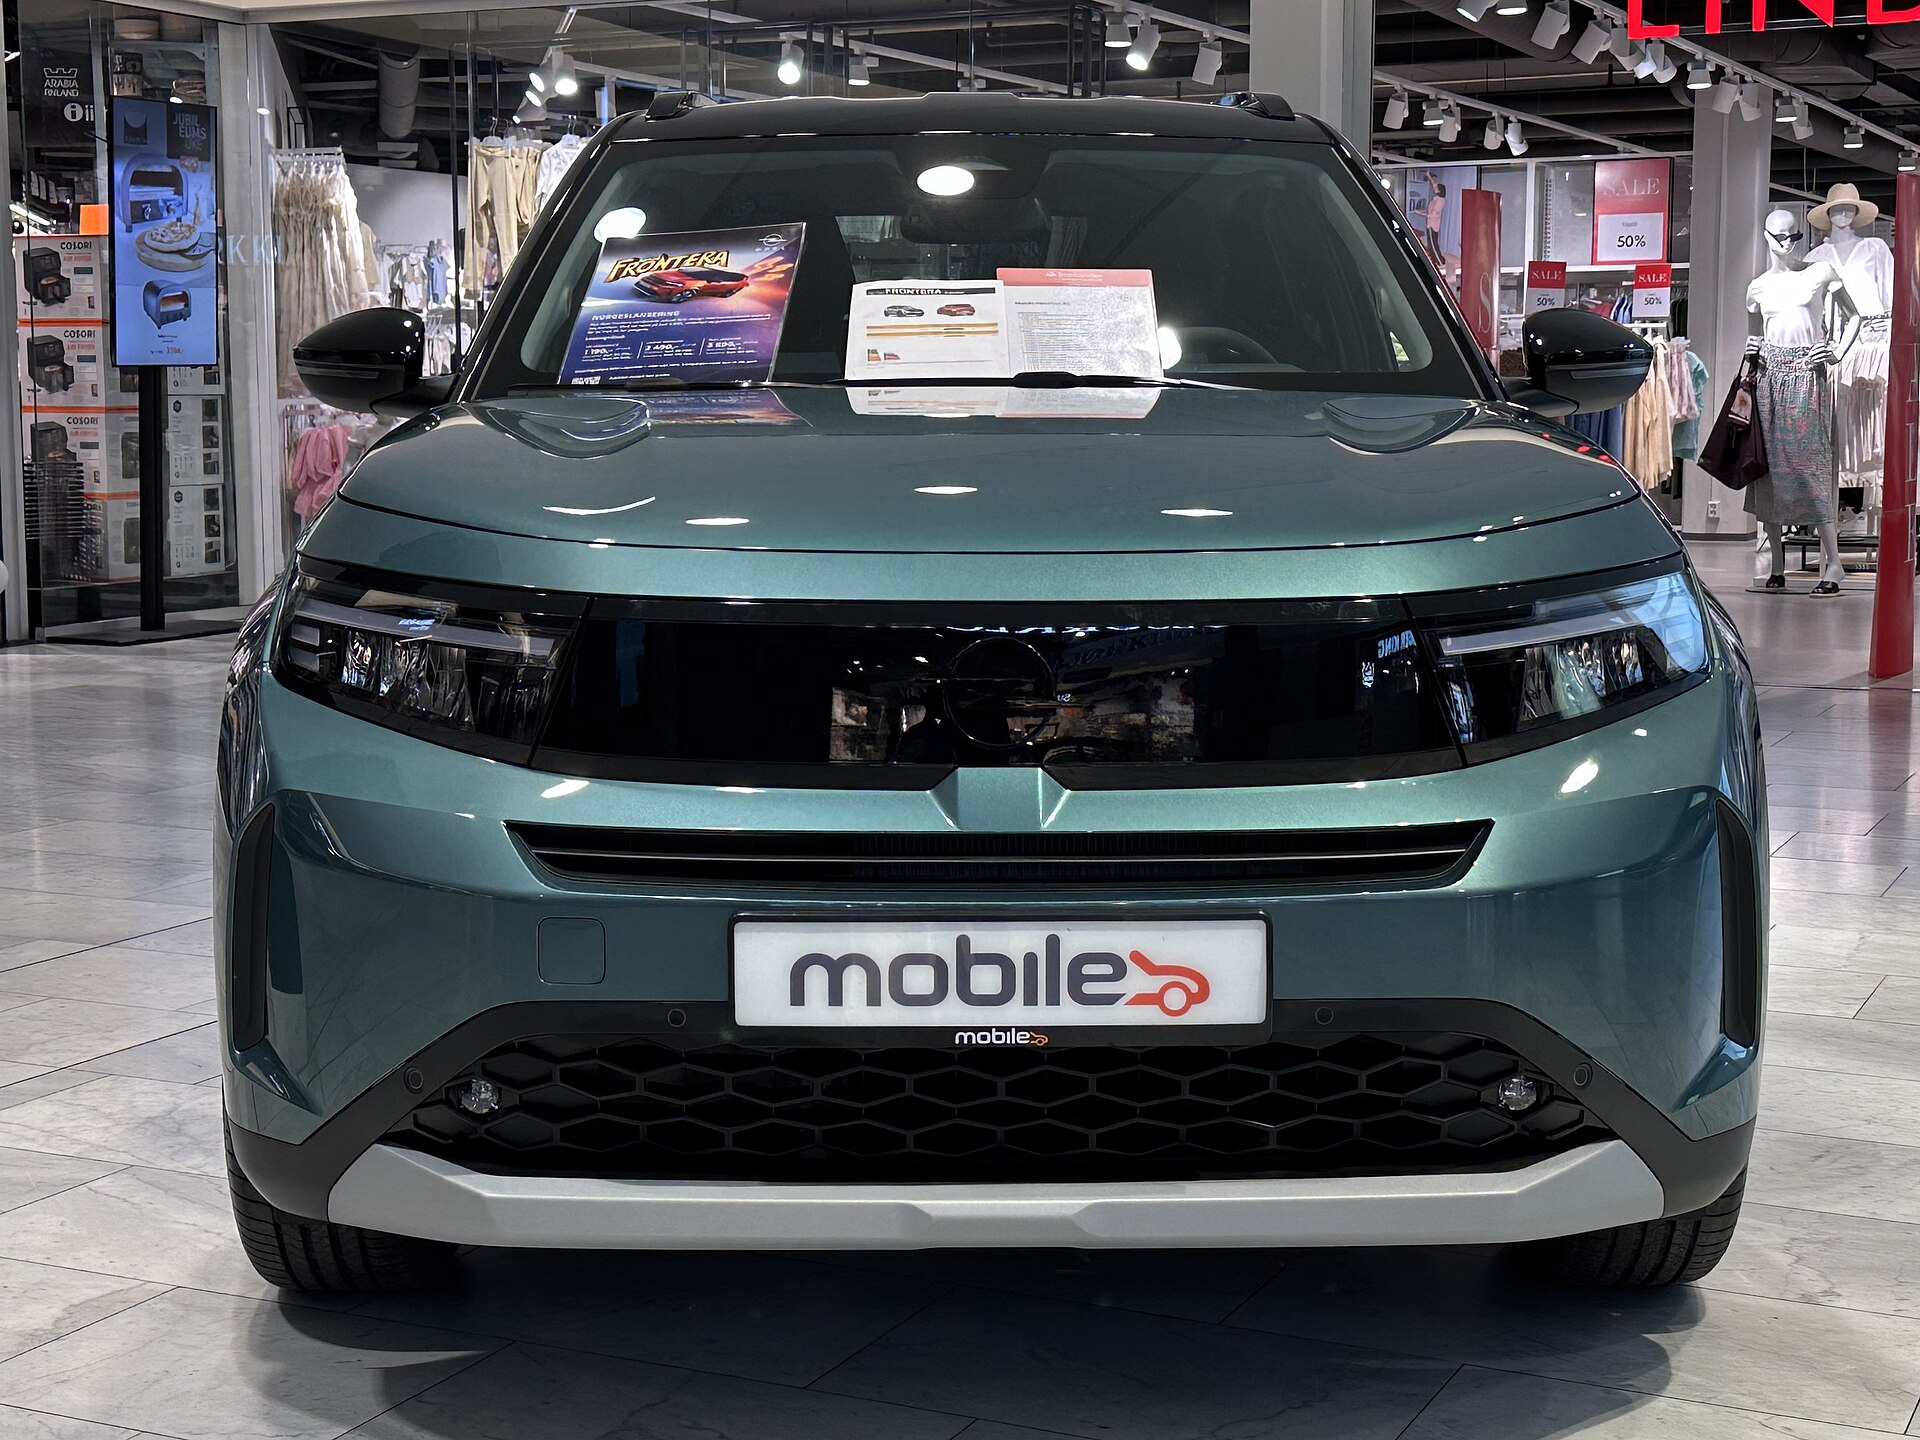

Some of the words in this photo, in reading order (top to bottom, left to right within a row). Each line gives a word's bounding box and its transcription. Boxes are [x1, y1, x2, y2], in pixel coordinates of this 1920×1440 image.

[44, 80, 78, 88] ARABIA
[1603, 177, 1660, 196] SALE
[1617, 234, 1646, 248] 50%
[604, 250, 729, 282] FRONTERA
[1531, 270, 1562, 281] SALE
[1638, 273, 1667, 283] SALE
[1536, 297, 1555, 306] 50%
[1644, 297, 1662, 305] 50%
[790, 933, 1128, 1008] mobile
[954, 1027, 1030, 1045] mobile
